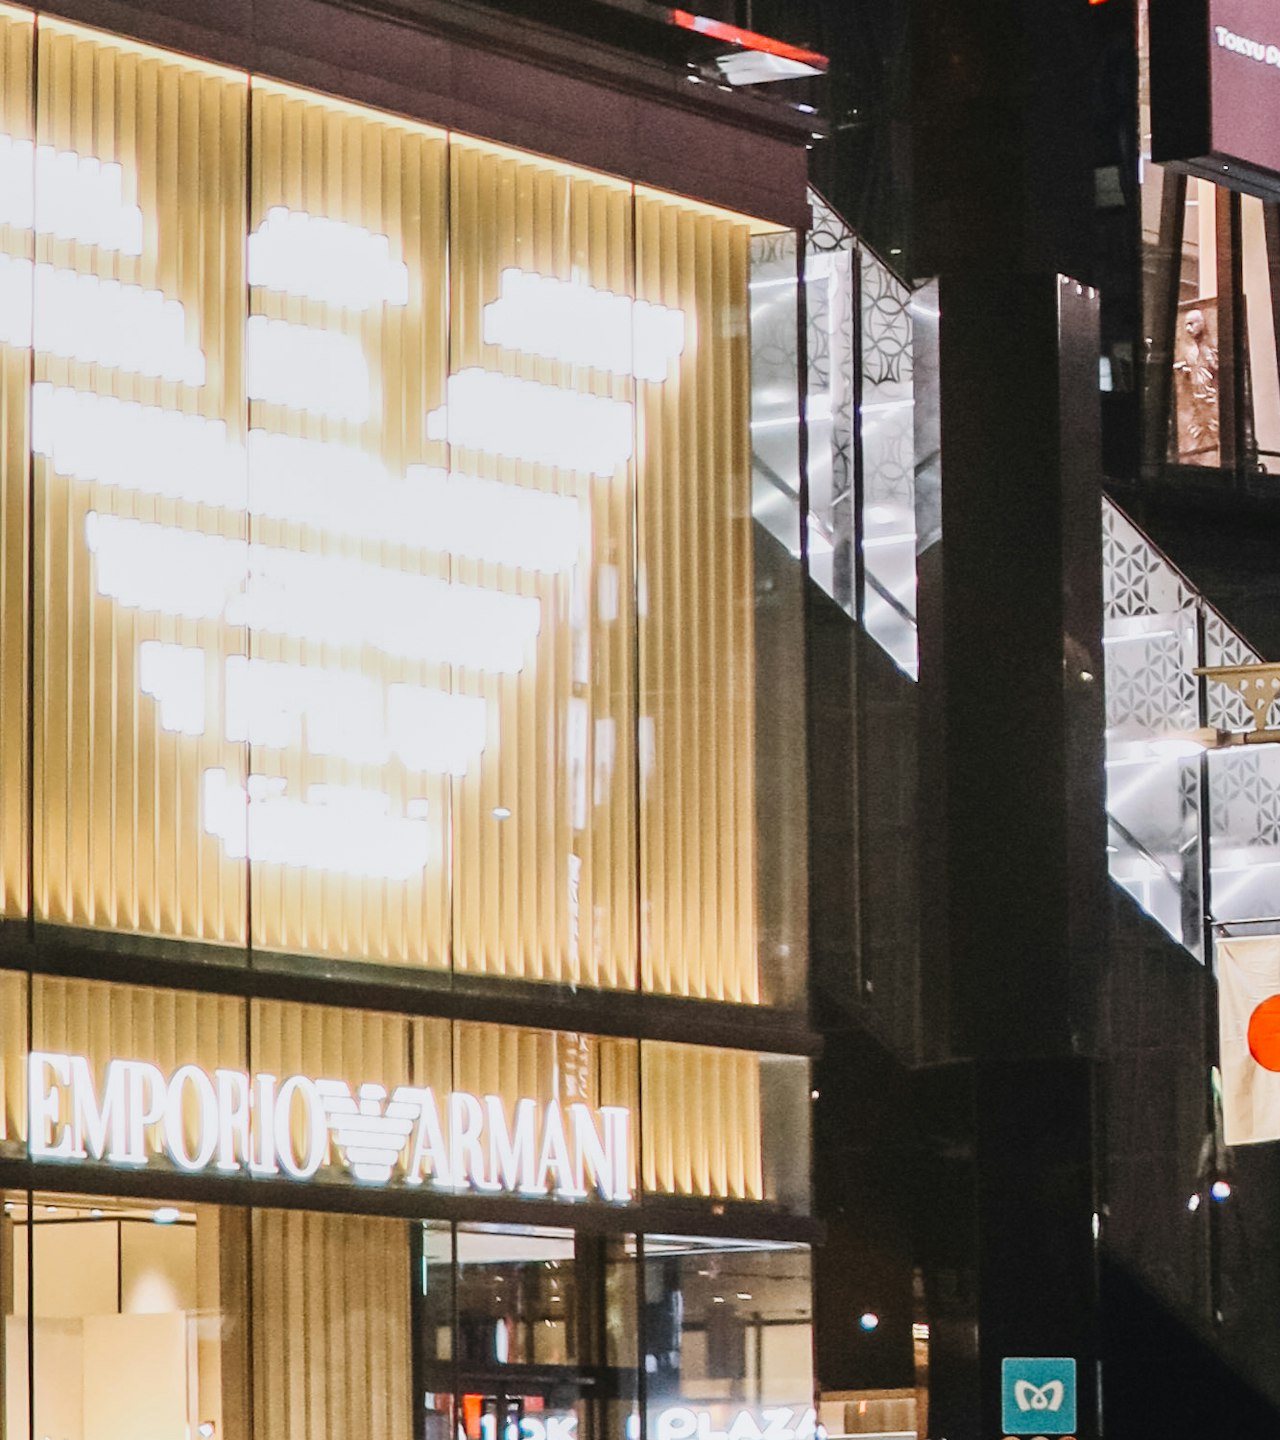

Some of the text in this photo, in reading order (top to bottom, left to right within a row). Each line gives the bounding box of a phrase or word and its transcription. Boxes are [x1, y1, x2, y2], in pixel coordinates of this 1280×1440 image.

[1214, 25, 1265, 62] TOKYU
[28, 1051, 633, 1203] EMPORIO ARMANI
